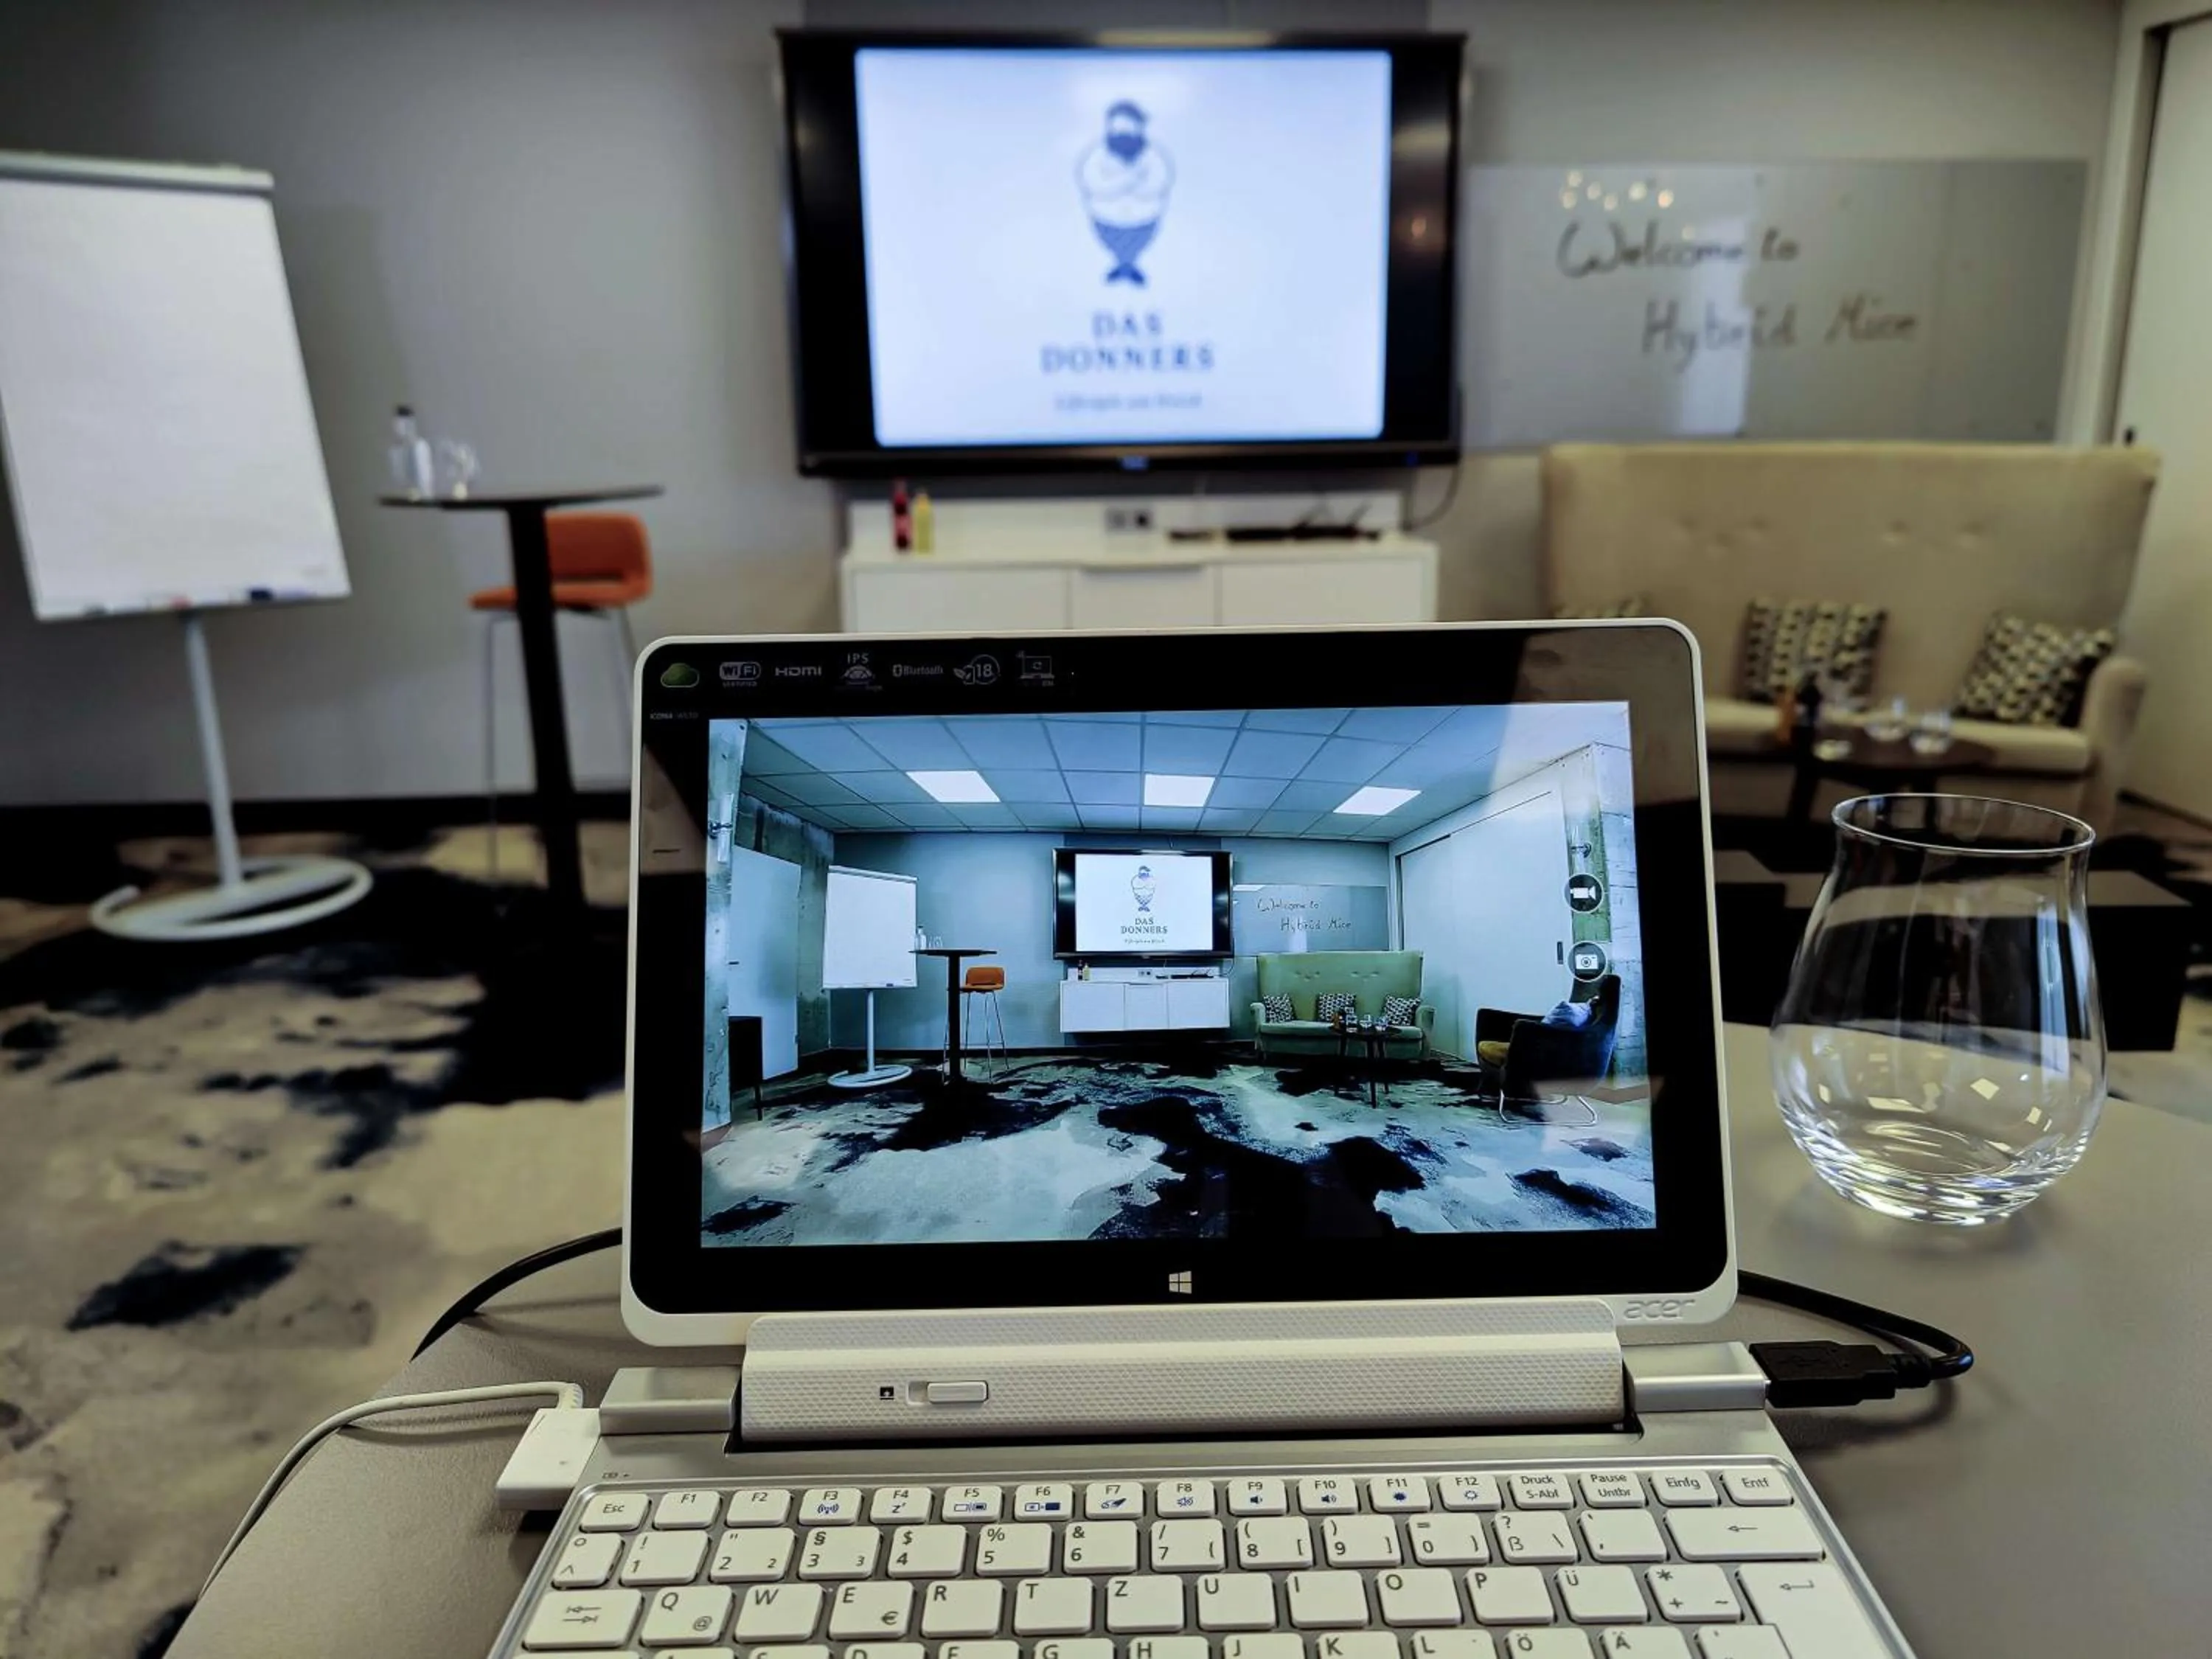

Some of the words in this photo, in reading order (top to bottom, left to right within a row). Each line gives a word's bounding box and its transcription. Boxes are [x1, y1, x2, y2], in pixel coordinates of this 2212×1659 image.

[1555, 220, 1743, 279] Welcome
[1759, 226, 1800, 261] to
[1093, 313, 1163, 336] DAS
[1641, 296, 1796, 373] Hybrid
[1040, 344, 1215, 372] DONNERS
[847, 653, 869, 664] IPS
[975, 664, 993, 677] 18
[1135, 917, 1154, 925] DAS
[1121, 925, 1168, 934] DONNERS
[1624, 1299, 1695, 1319] acer
[1315, 1480, 1337, 1489] F10
[1386, 1478, 1408, 1487] F11
[1455, 1477, 1479, 1486] F12
[1520, 1475, 1555, 1485] Druck
[1590, 1474, 1627, 1483] Pause
[1665, 1477, 1701, 1490] Einfg
[1741, 1477, 1769, 1488] Entf
[964, 1488, 980, 1498] F5
[1035, 1486, 1051, 1496] F6
[1105, 1484, 1121, 1495] F7
[1177, 1483, 1192, 1492] F8
[1248, 1481, 1263, 1491] F9
[1598, 1487, 1631, 1498] Untbr
[681, 1493, 697, 1503] F1
[751, 1491, 770, 1502] F2
[823, 1489, 839, 1500] F3
[892, 1489, 909, 1499] F4
[1526, 1489, 1559, 1499] S-Abf
[602, 1503, 625, 1514] Esc
[1501, 1515, 1511, 1528] ?
[902, 1530, 913, 1545] $
[987, 1527, 1005, 1543] %
[1072, 1526, 1085, 1539] &
[1158, 1546, 1169, 1560] 7
[1247, 1543, 1259, 1558] 8
[1334, 1541, 1346, 1556] 9
[1422, 1540, 1434, 1554] 0
[807, 1554, 820, 1568] 3
[896, 1552, 908, 1565] 4
[984, 1551, 995, 1565] 5
[1070, 1548, 1082, 1562] 6
[633, 1559, 641, 1573] 1
[719, 1557, 732, 1570] 2
[1385, 1573, 1403, 1590] O
[1475, 1572, 1488, 1589] P
[1565, 1570, 1579, 1586] Ü
[933, 1585, 947, 1601] R
[1026, 1583, 1039, 1599] T
[1114, 1580, 1127, 1597] Z
[1204, 1578, 1220, 1595] U
[661, 1592, 679, 1611] Q
[753, 1587, 779, 1605] W
[843, 1586, 855, 1604] E
[1326, 1638, 1343, 1655] K
[1421, 1635, 1436, 1654] L
[1515, 1632, 1534, 1652] Ö
[1612, 1630, 1632, 1650] Ä
[1042, 1644, 1059, 1659] G
[1137, 1642, 1152, 1657] H
[1233, 1639, 1241, 1657] J
